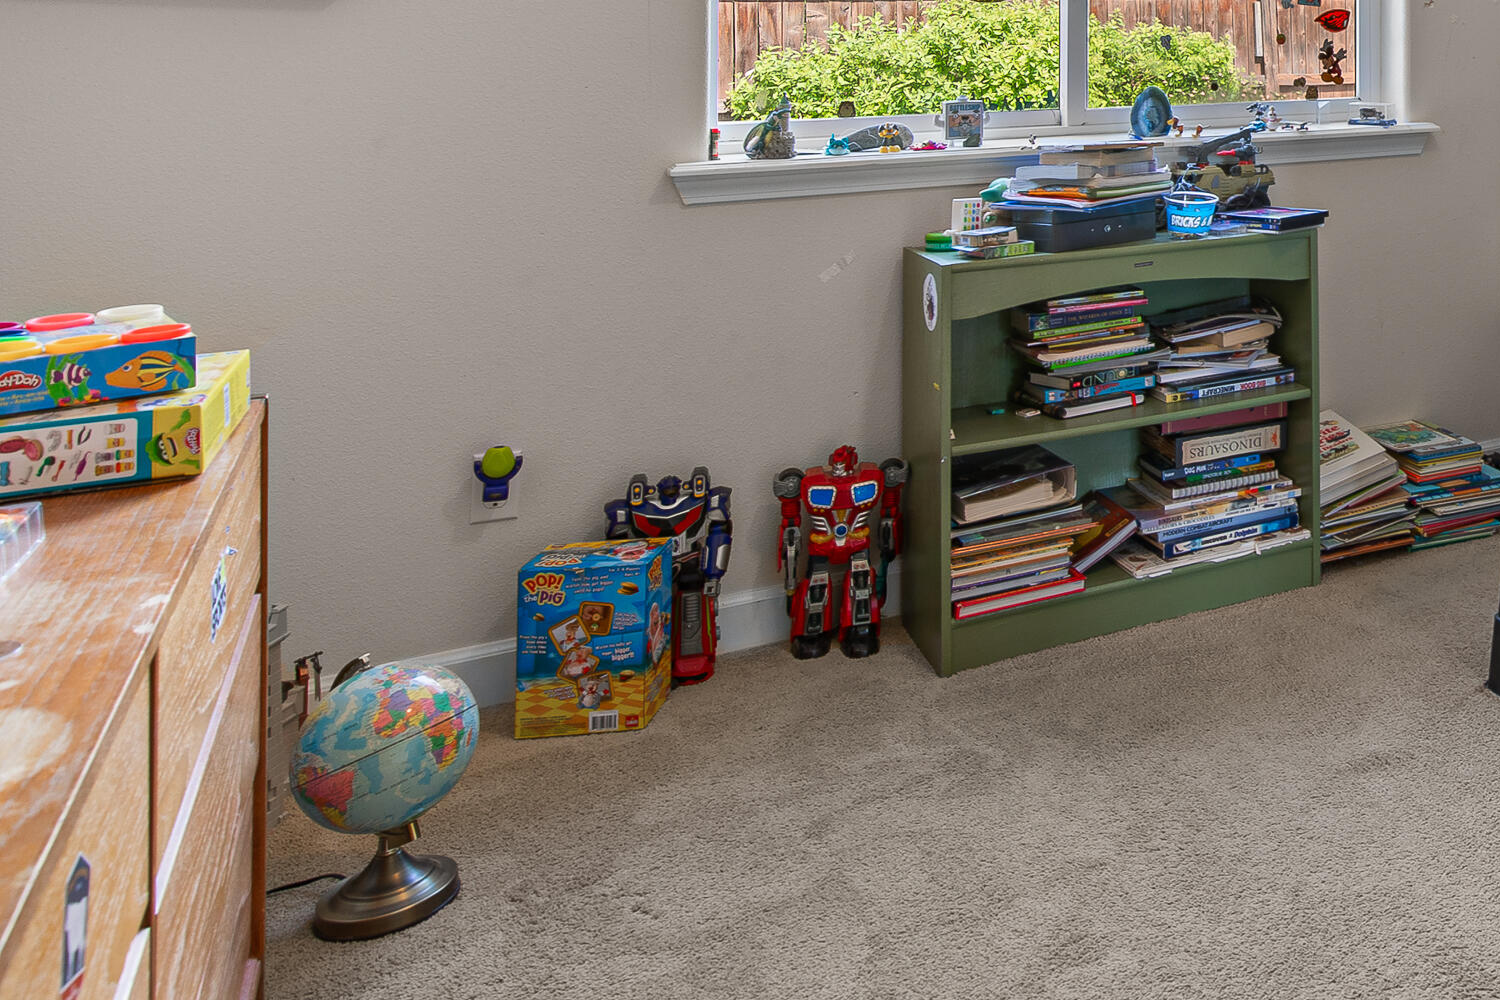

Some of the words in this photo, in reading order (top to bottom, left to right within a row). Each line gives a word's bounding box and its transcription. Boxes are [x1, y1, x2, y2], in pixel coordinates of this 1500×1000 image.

[1171, 214, 1200, 228] BRICKS
[1189, 435, 1263, 459] DINOSAURS
[523, 573, 563, 594] POP!
